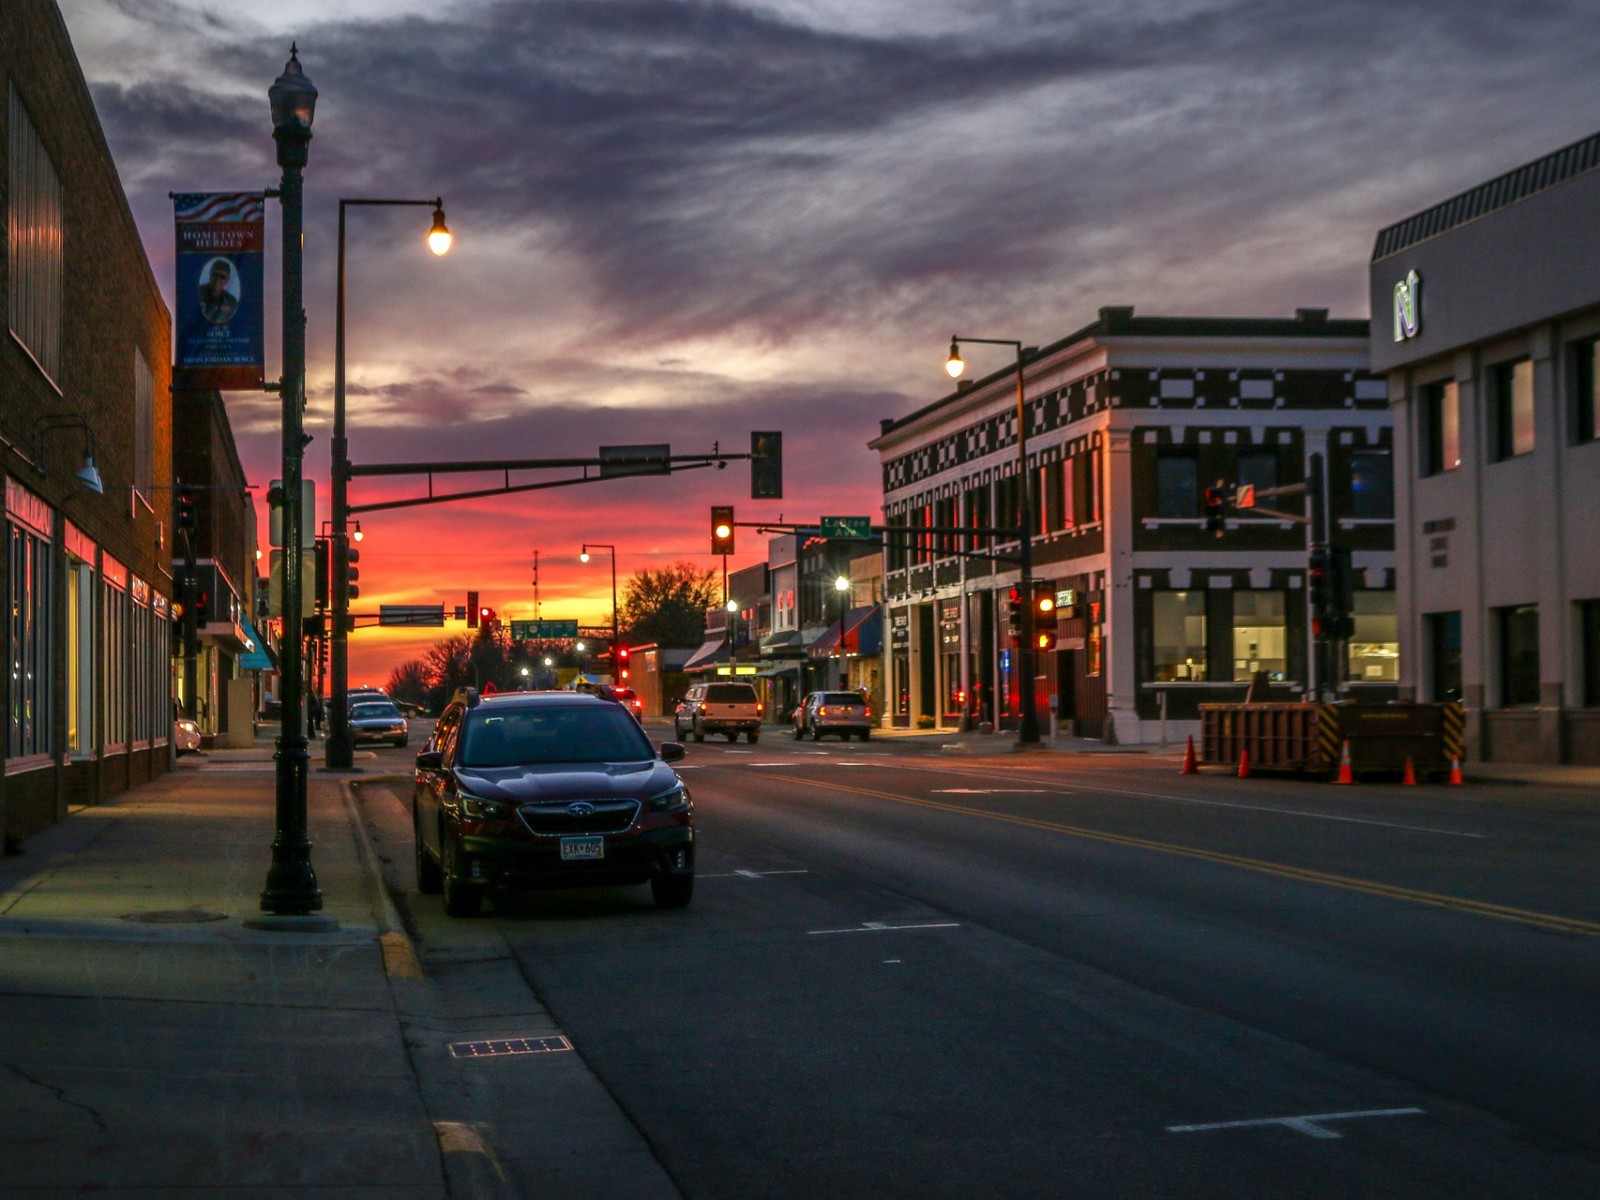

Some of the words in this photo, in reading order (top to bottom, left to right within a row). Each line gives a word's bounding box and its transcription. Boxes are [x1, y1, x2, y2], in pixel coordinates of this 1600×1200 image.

[183, 231, 254, 240] HOMETOWN
[196, 239, 242, 248] HEROES
[824, 518, 866, 528] LaBree
[835, 528, 857, 537] Ave
